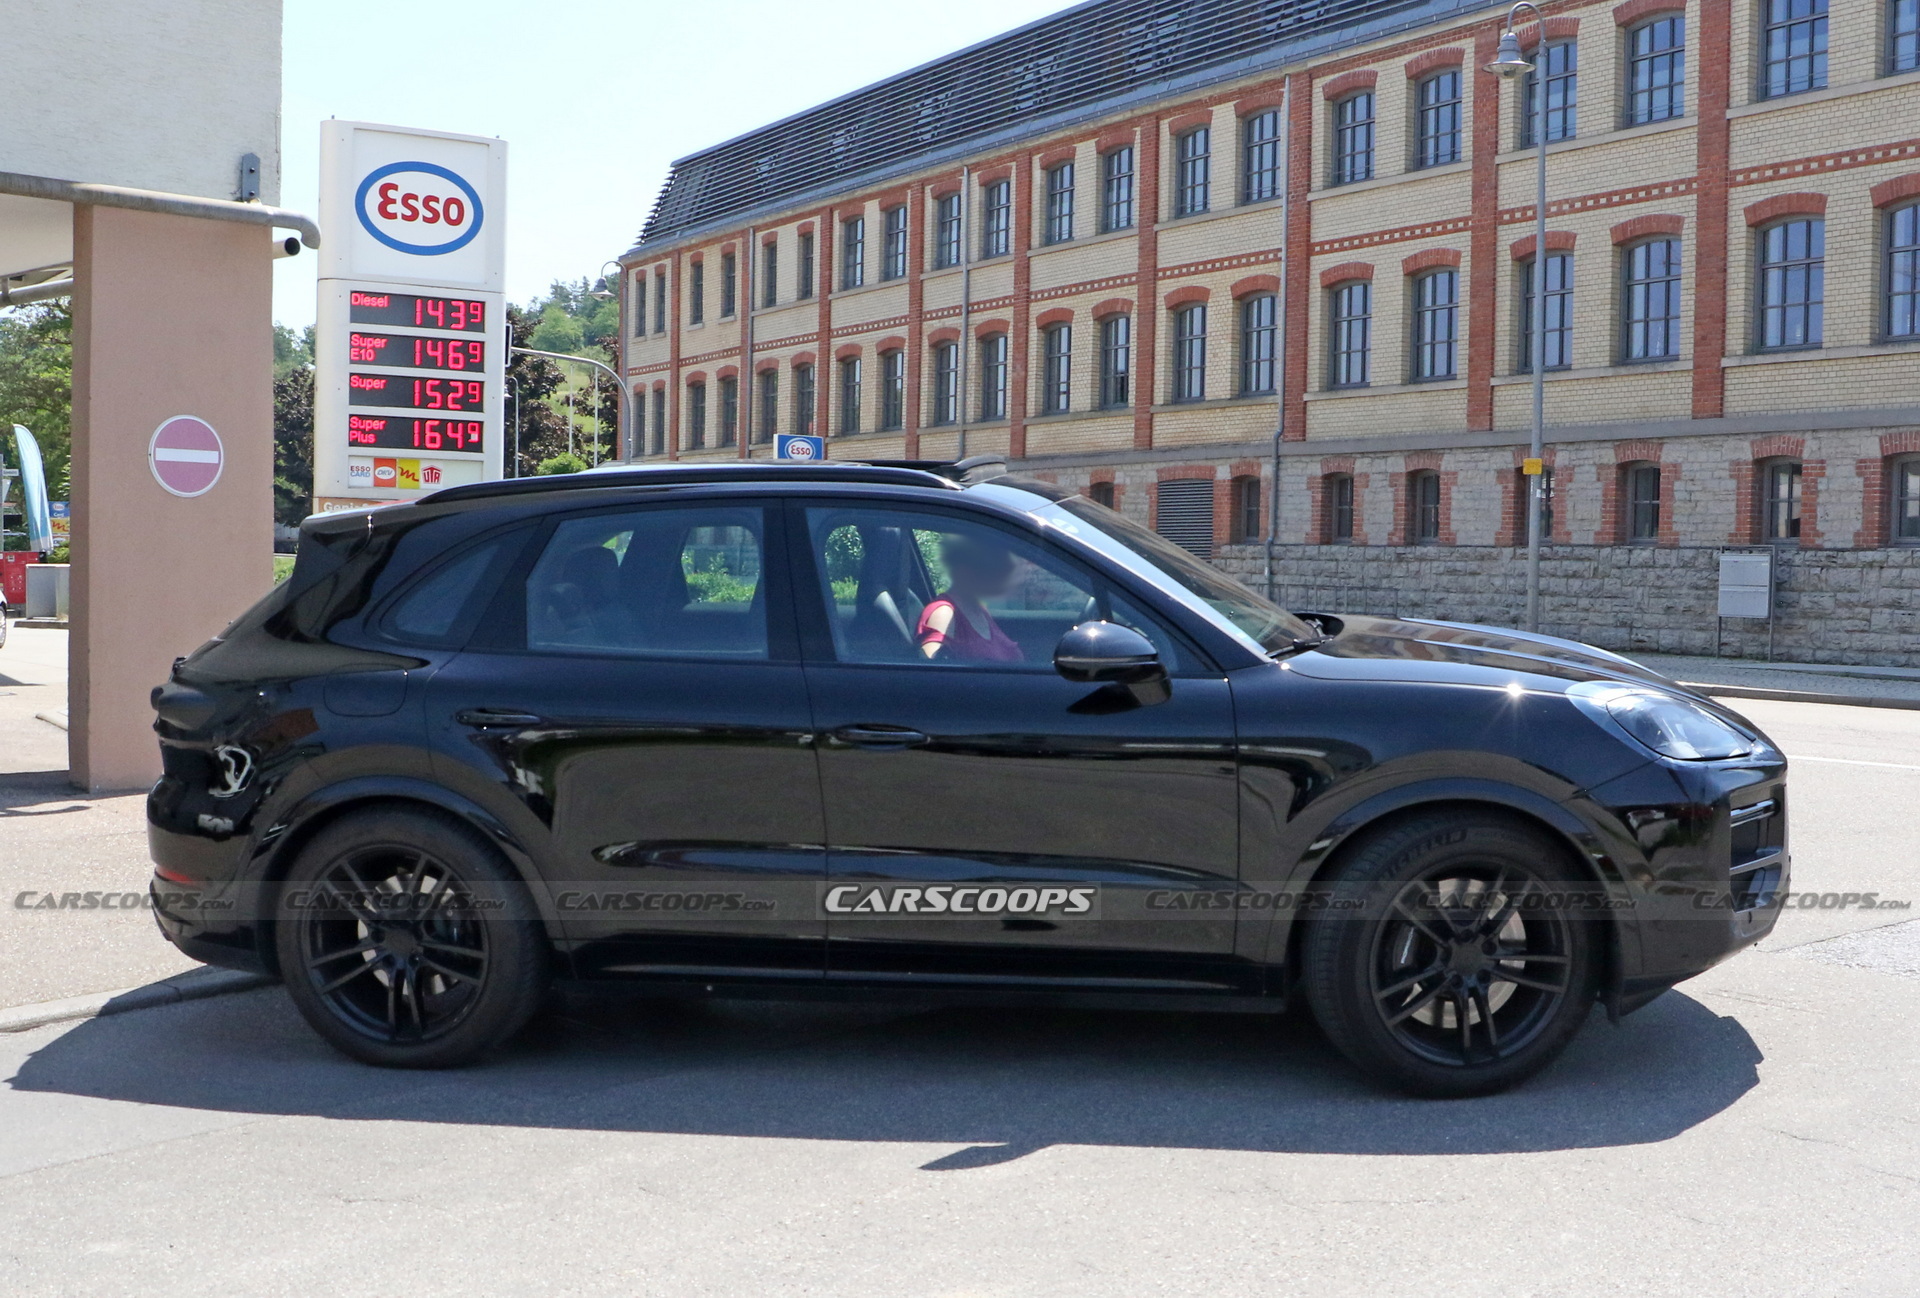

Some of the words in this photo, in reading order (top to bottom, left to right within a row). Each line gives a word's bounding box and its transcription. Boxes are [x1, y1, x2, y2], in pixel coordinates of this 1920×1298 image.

[378, 183, 465, 226] Esso
[351, 292, 389, 308] Diesel
[415, 299, 482, 329] 1439
[350, 333, 388, 350] Super
[414, 339, 481, 369] 1469
[350, 347, 376, 362] E10
[350, 374, 387, 391] Super
[414, 380, 479, 409] 1529
[349, 415, 387, 433] Super
[413, 420, 479, 449] 1649
[349, 430, 377, 444] Plus
[791, 445, 811, 455] Esso
